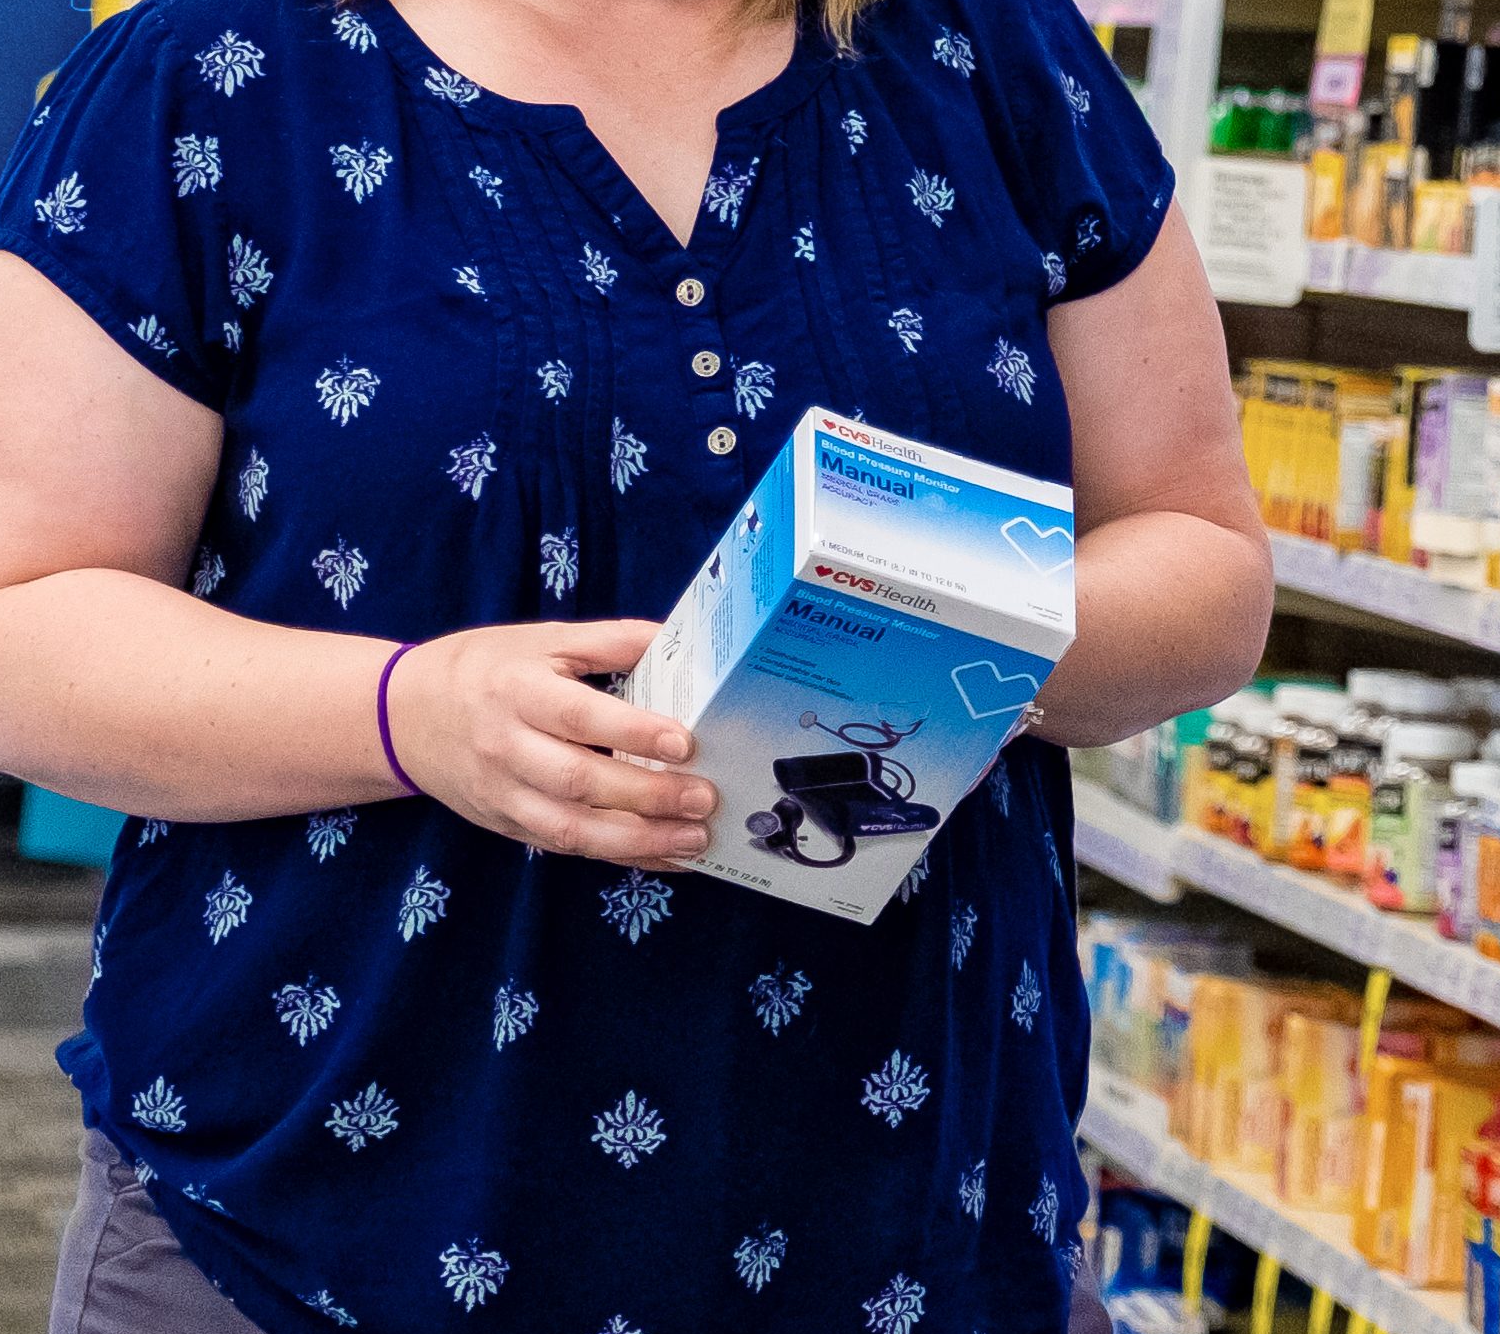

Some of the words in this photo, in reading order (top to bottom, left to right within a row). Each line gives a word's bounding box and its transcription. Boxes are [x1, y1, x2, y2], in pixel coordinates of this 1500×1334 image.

[821, 439, 855, 460] Blood
[858, 451, 911, 479] Pressure
[914, 470, 961, 495] Monitor
[821, 451, 915, 500] Manual
[783, 599, 888, 643] Manual
[796, 588, 833, 608] Blood
[834, 600, 891, 625] Pressure
[891, 620, 941, 641] Monitor
